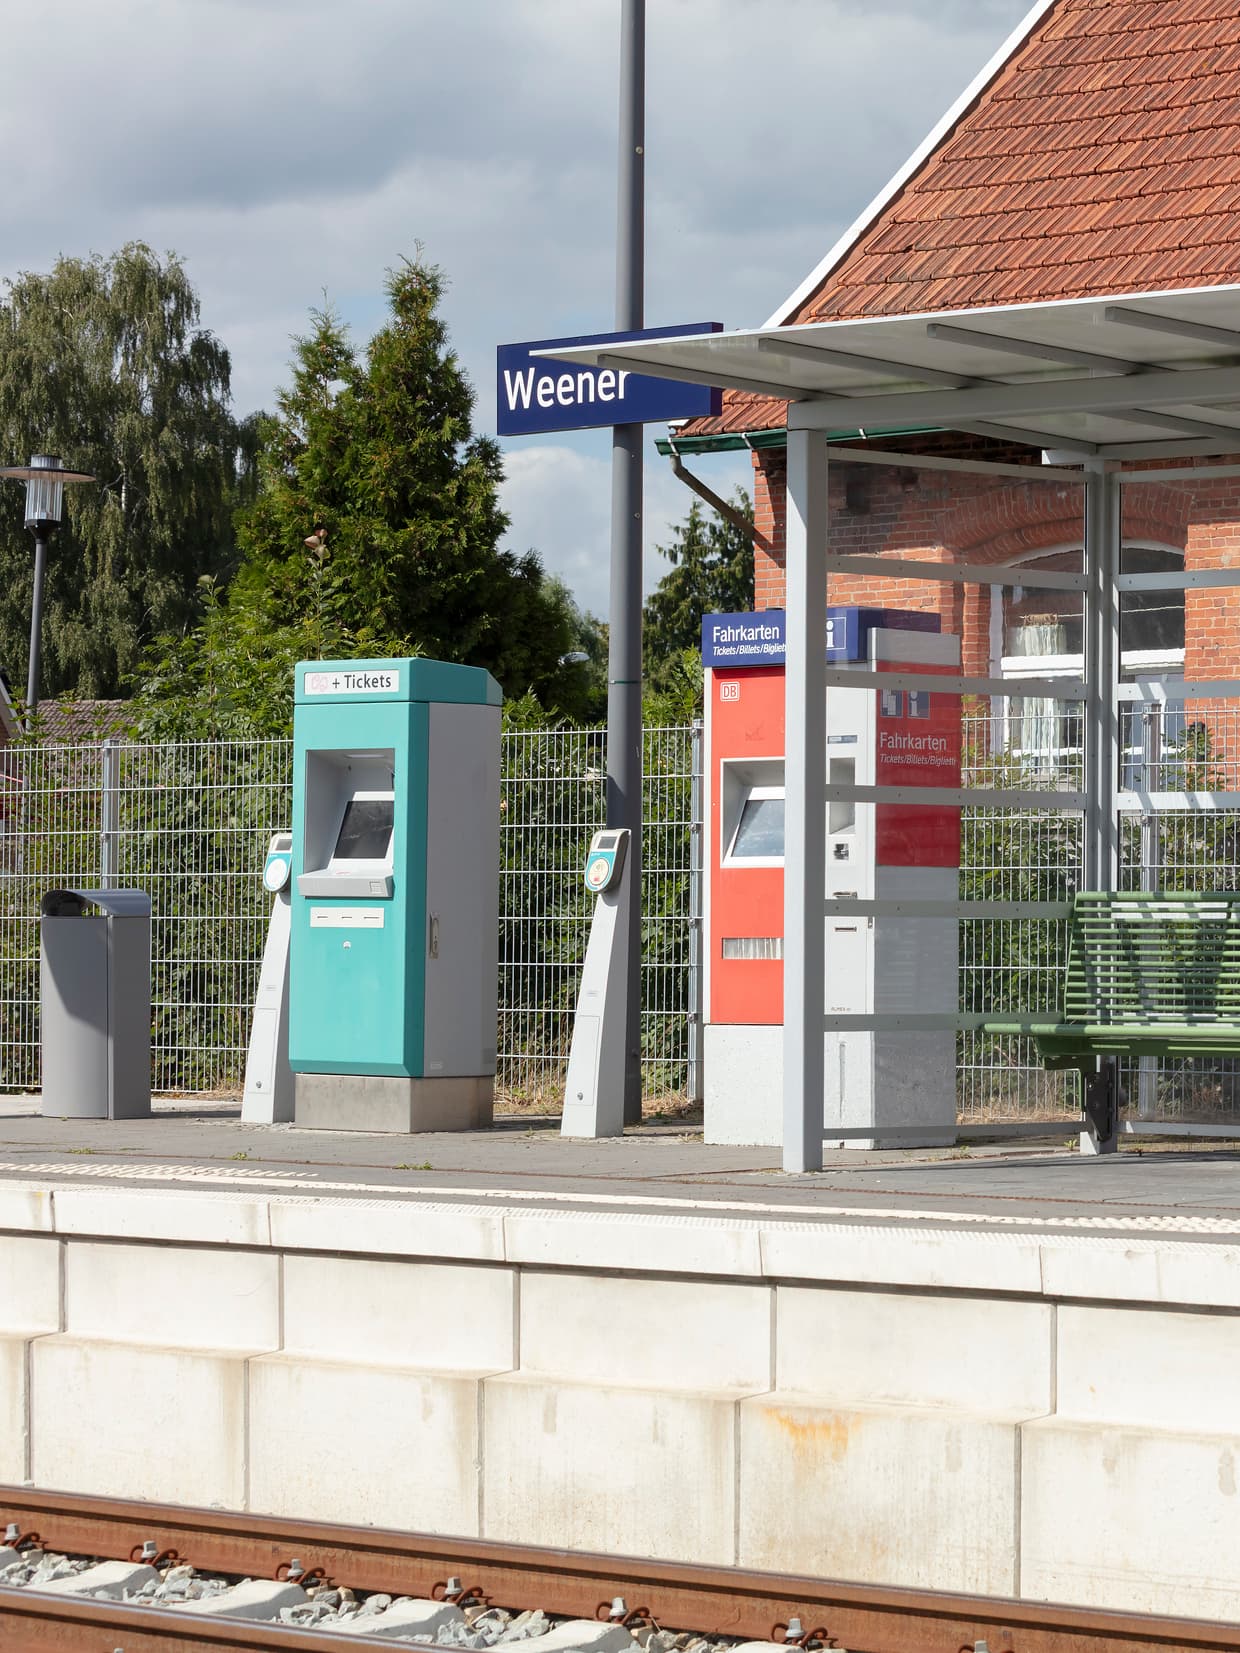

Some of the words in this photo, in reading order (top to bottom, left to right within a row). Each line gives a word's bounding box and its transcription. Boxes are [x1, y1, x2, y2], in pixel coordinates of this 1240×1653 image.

[504, 367, 631, 411] Weener
[713, 624, 780, 643] Fahrkarten
[344, 673, 392, 689] Tickets
[722, 685, 738, 699] DB
[880, 732, 947, 751] Fahrkarten
